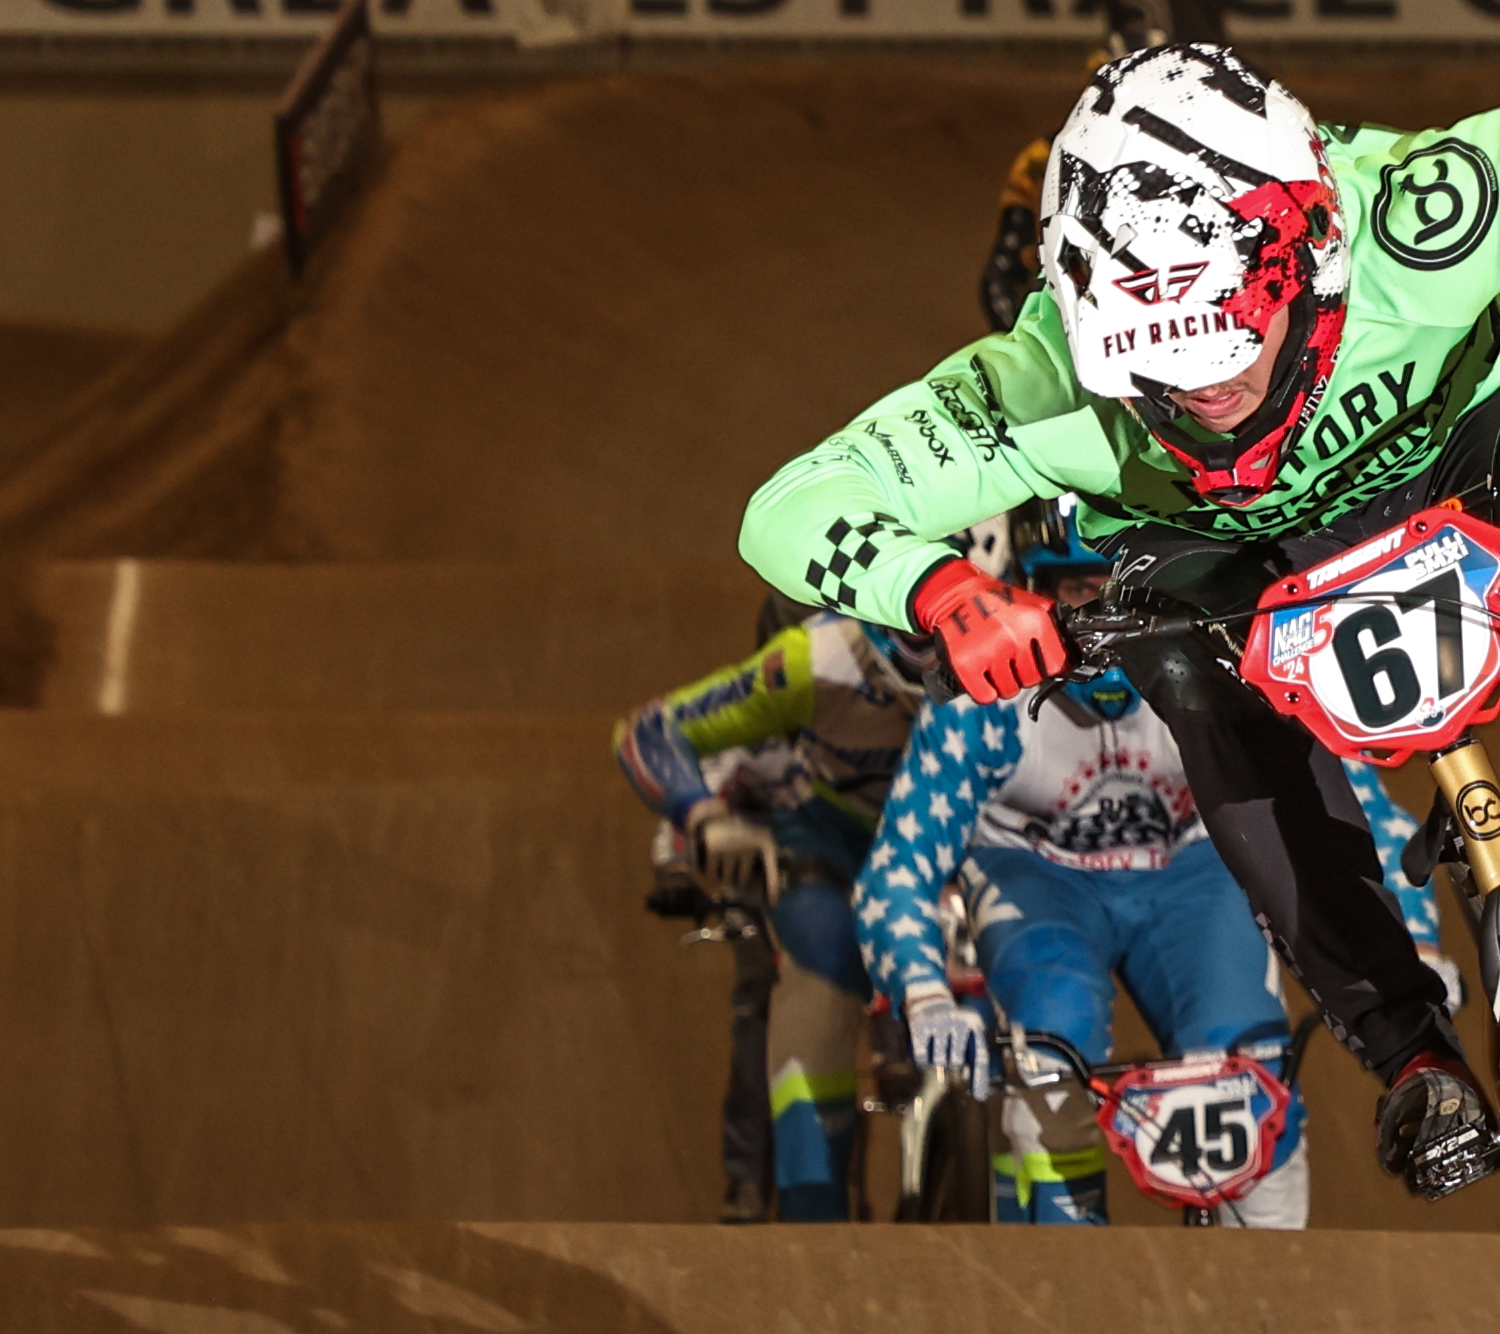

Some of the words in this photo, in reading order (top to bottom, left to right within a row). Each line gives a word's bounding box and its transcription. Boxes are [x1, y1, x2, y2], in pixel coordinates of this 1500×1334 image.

[1102, 326, 1138, 358] FLY
[1148, 309, 1248, 346] RACING
[919, 423, 955, 469] box
[1306, 527, 1408, 590] TANGENT
[1331, 567, 1466, 729] 67
[1150, 1099, 1249, 1180] 45
